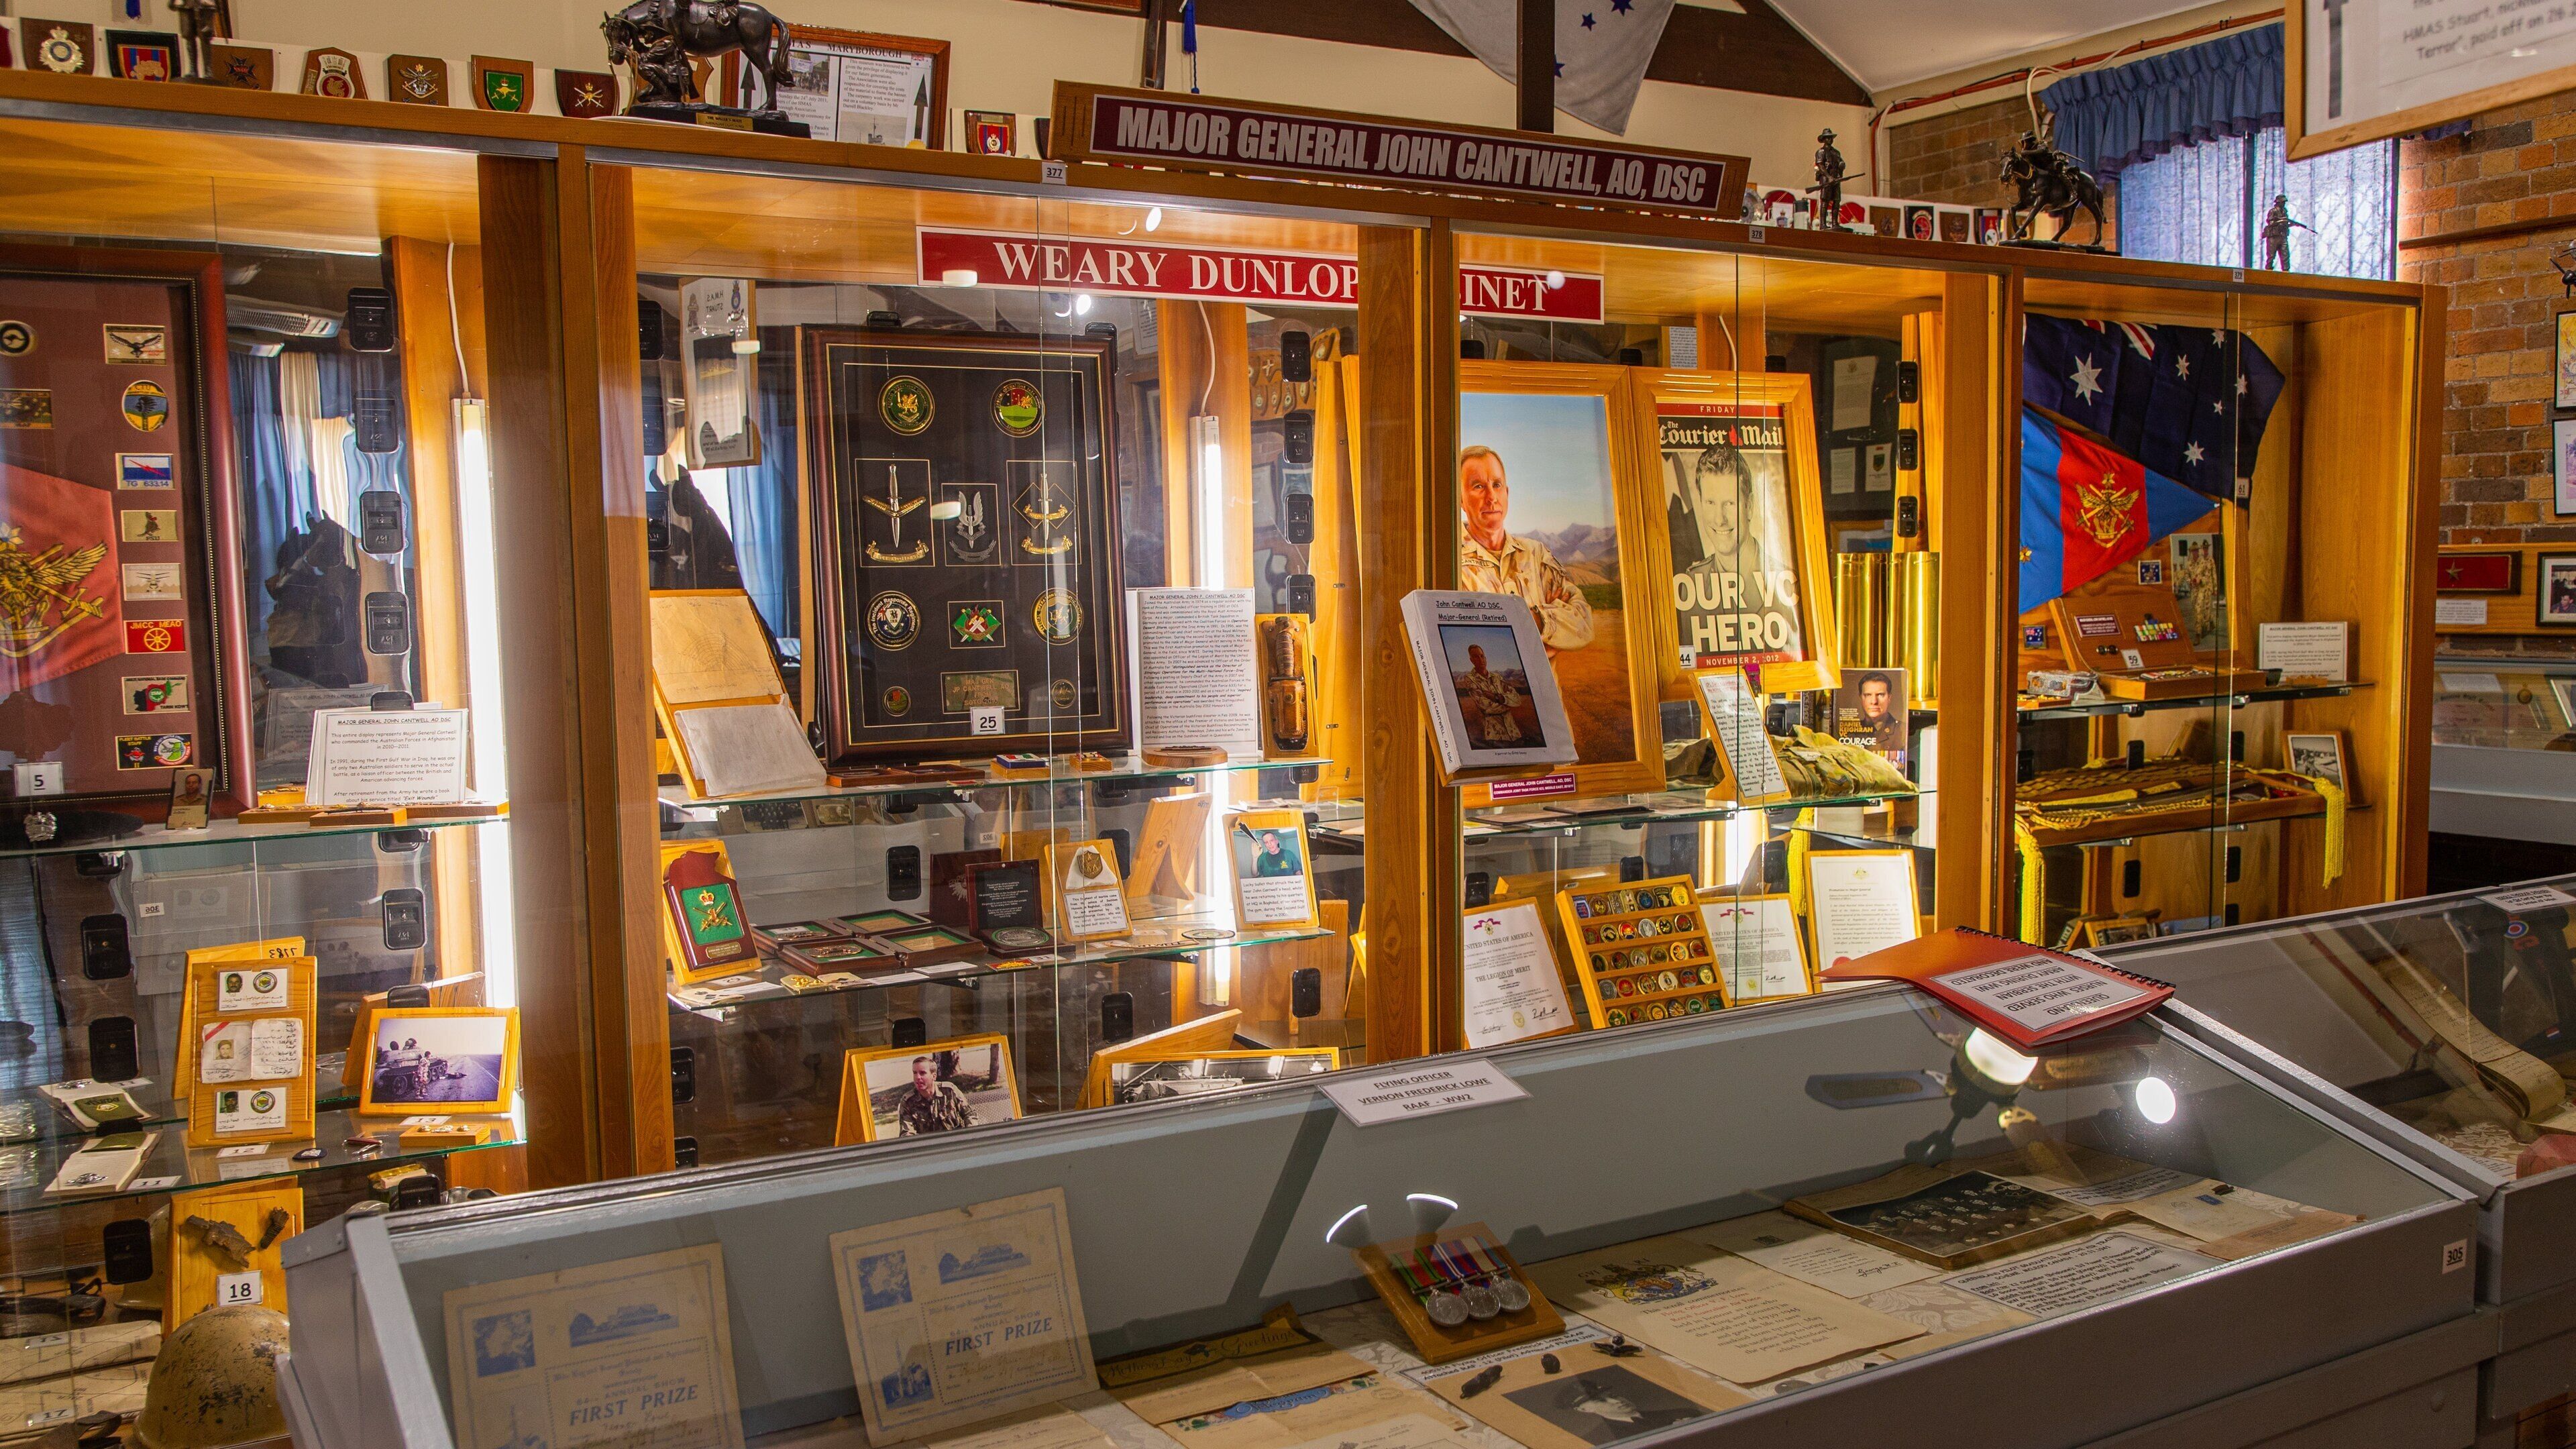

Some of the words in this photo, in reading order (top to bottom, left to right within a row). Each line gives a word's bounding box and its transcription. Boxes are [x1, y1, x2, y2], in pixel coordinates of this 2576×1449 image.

[2403, 21, 2444, 42] HMAS
[2501, 17, 2523, 36] off
[828, 44, 902, 58] MARYBOROUGH
[1117, 107, 1230, 156] MAJOR
[1238, 118, 1368, 168] GENERAL
[1375, 132, 1450, 176] JOHN
[1456, 141, 1601, 195] CANTWELL,
[1607, 157, 1647, 198] AO,
[1653, 162, 1707, 203] DSC
[1046, 168, 1063, 176] 377
[993, 242, 1167, 288] WEARY
[1188, 255, 1358, 297] DUNLOP
[1659, 424, 1727, 445] Courier
[1741, 425, 1784, 446] Mail
[1673, 572, 1747, 610] OUR
[1753, 571, 1799, 607] VC
[871, 601, 883, 621] Incident
[883, 598, 908, 607] Response
[908, 606, 916, 631] Regiment
[1690, 612, 1787, 653] HERO
[1680, 654, 1690, 663] 44
[1707, 657, 1748, 665] NOVEMBER
[1752, 656, 1760, 664] 2,
[2129, 656, 2137, 664] 59
[1422, 661, 1431, 686] GENERAL
[980, 716, 996, 728] 25
[1839, 737, 1876, 745] COURAGE
[34, 775, 43, 786] 5
[1483, 938, 1502, 947] STATES
[1511, 932, 1534, 941] AMERICA
[2007, 963, 2031, 973] WERE
[2031, 959, 2053, 968] AND
[1488, 971, 1507, 980] LEGION
[1515, 965, 1530, 974] MERIT
[1951, 969, 2006, 985] DECORATED
[2001, 971, 2039, 985] DURING
[2040, 967, 2065, 977] ARMY
[2058, 975, 2082, 984] WITH
[1975, 981, 2000, 993] WWI
[2039, 979, 2057, 988] THE
[2070, 980, 2108, 993] NURSES
[1996, 983, 2039, 1000] SERBIAN
[2047, 989, 2071, 1000] WHO
[2008, 996, 2046, 1012] SERVED
[1374, 1078, 1409, 1089] FLYING
[1411, 1071, 1452, 1083] OFFICER
[1358, 1091, 1404, 1104] VERNON
[1405, 1083, 1460, 1097] FREDERICK
[1460, 1077, 1491, 1087] LOWE
[1403, 1101, 1430, 1110] RAAF
[1442, 1093, 1472, 1103] WW2
[2449, 1247, 2463, 1260] 305
[229, 1283, 251, 1299] 18
[946, 1332, 994, 1355] FIRST
[1006, 1318, 1053, 1340] PRIZE
[570, 1399, 627, 1426] FIRST
[641, 1385, 698, 1410] PRIZE
